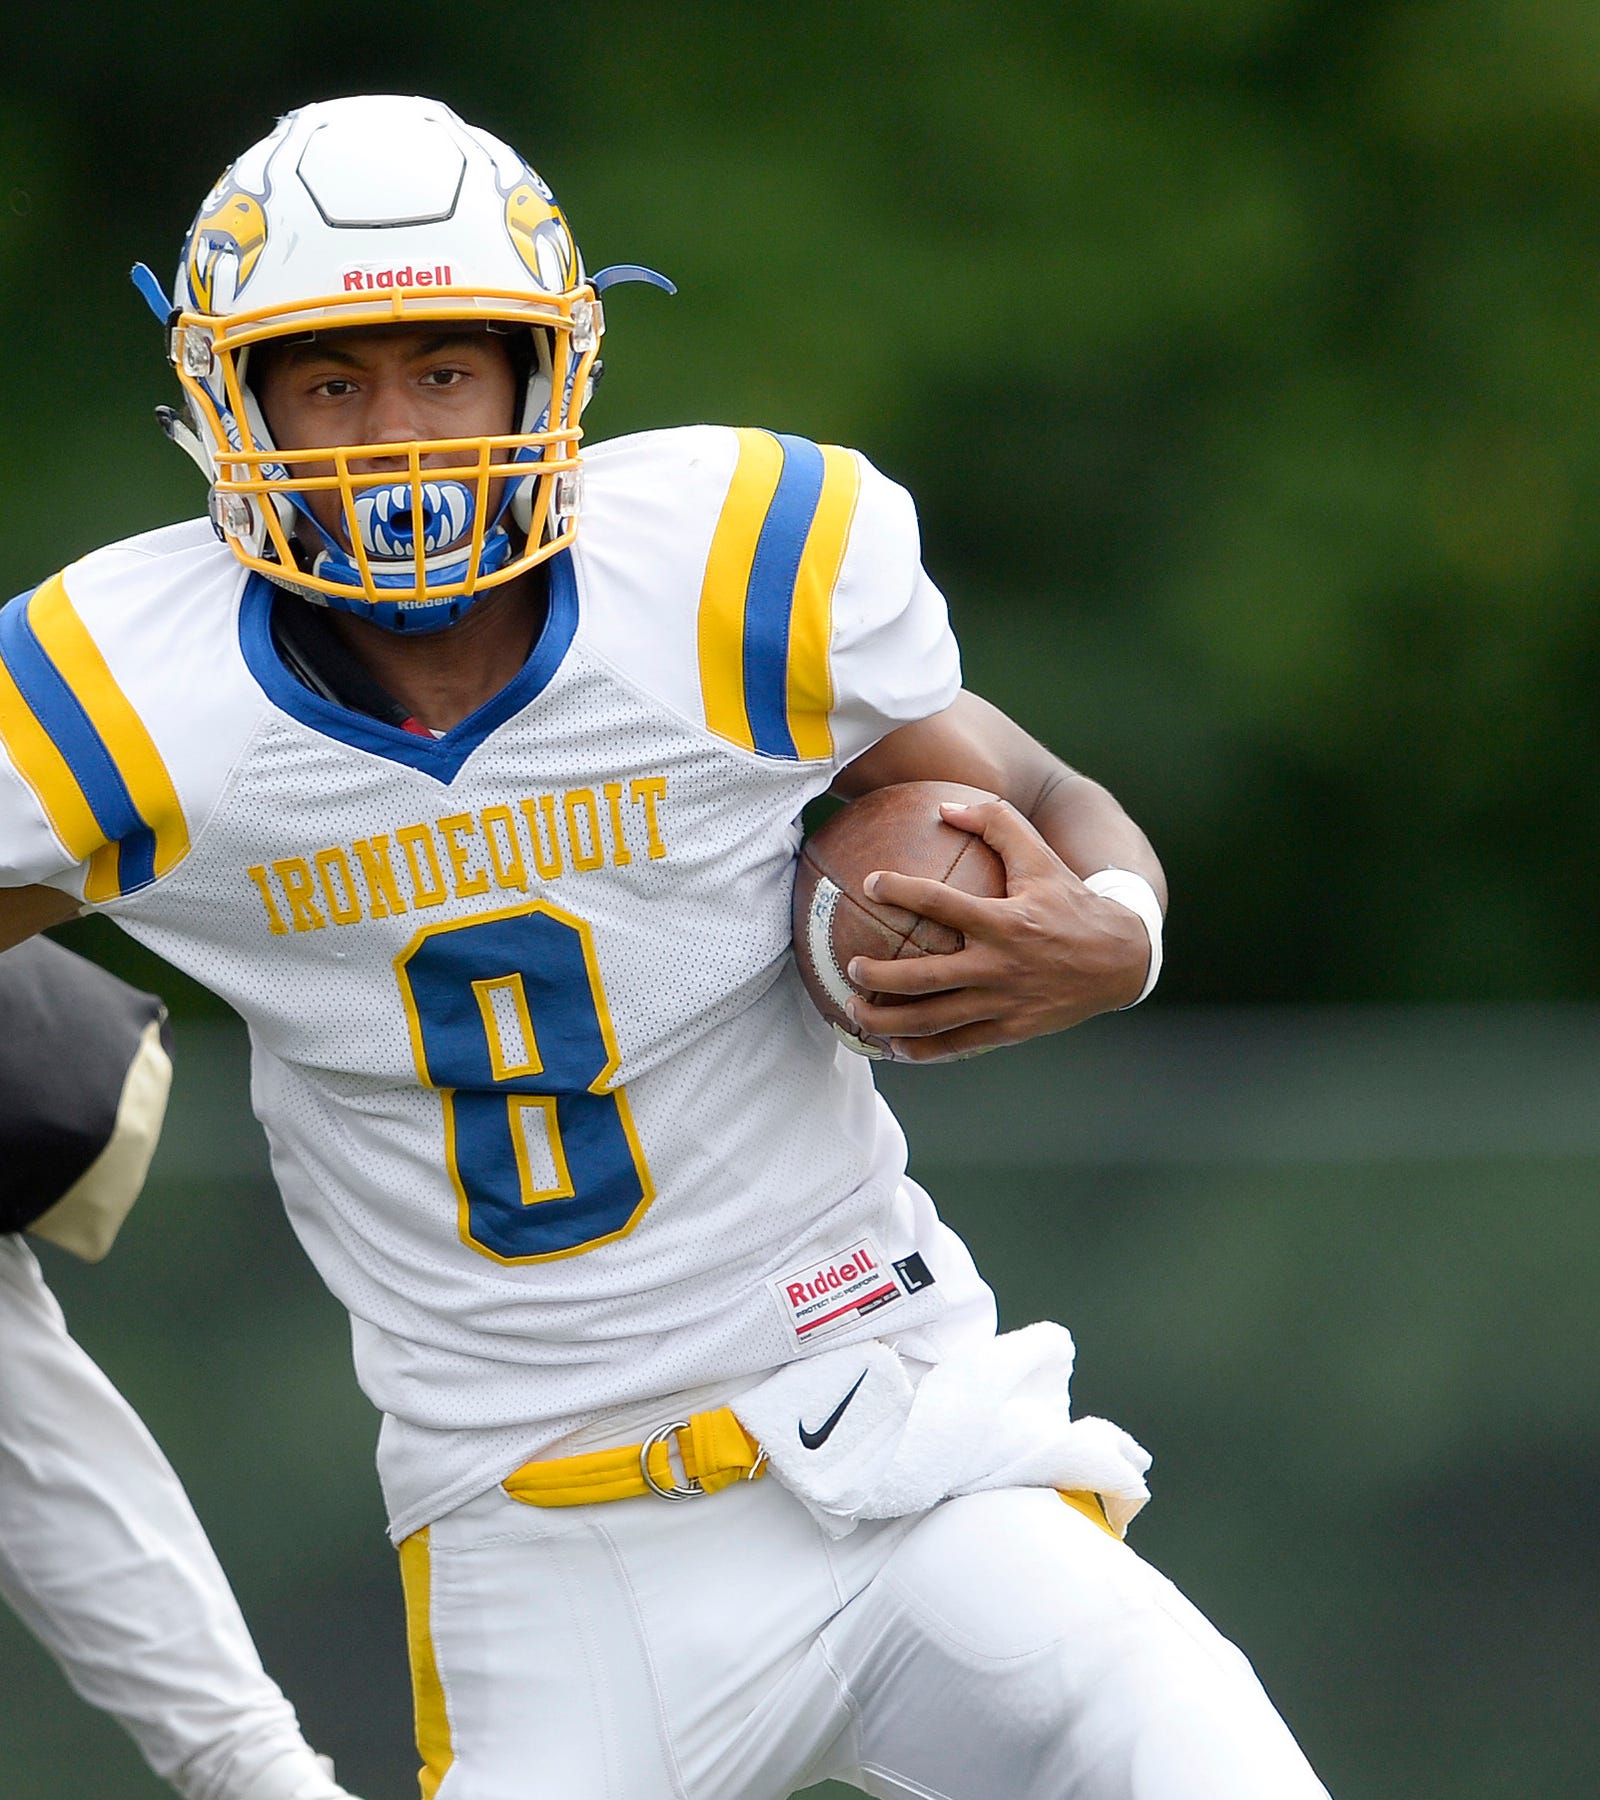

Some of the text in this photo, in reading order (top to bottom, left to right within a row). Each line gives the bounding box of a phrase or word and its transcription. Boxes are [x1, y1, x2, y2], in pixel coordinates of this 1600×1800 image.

[247, 776, 666, 935] IRONDEQUOIT
[392, 898, 657, 1267] 8
[786, 1249, 875, 1308] Riddell
[796, 1298, 830, 1318] PROTECT
[844, 1273, 879, 1295] PERFORM
[897, 1261, 922, 1289] L
